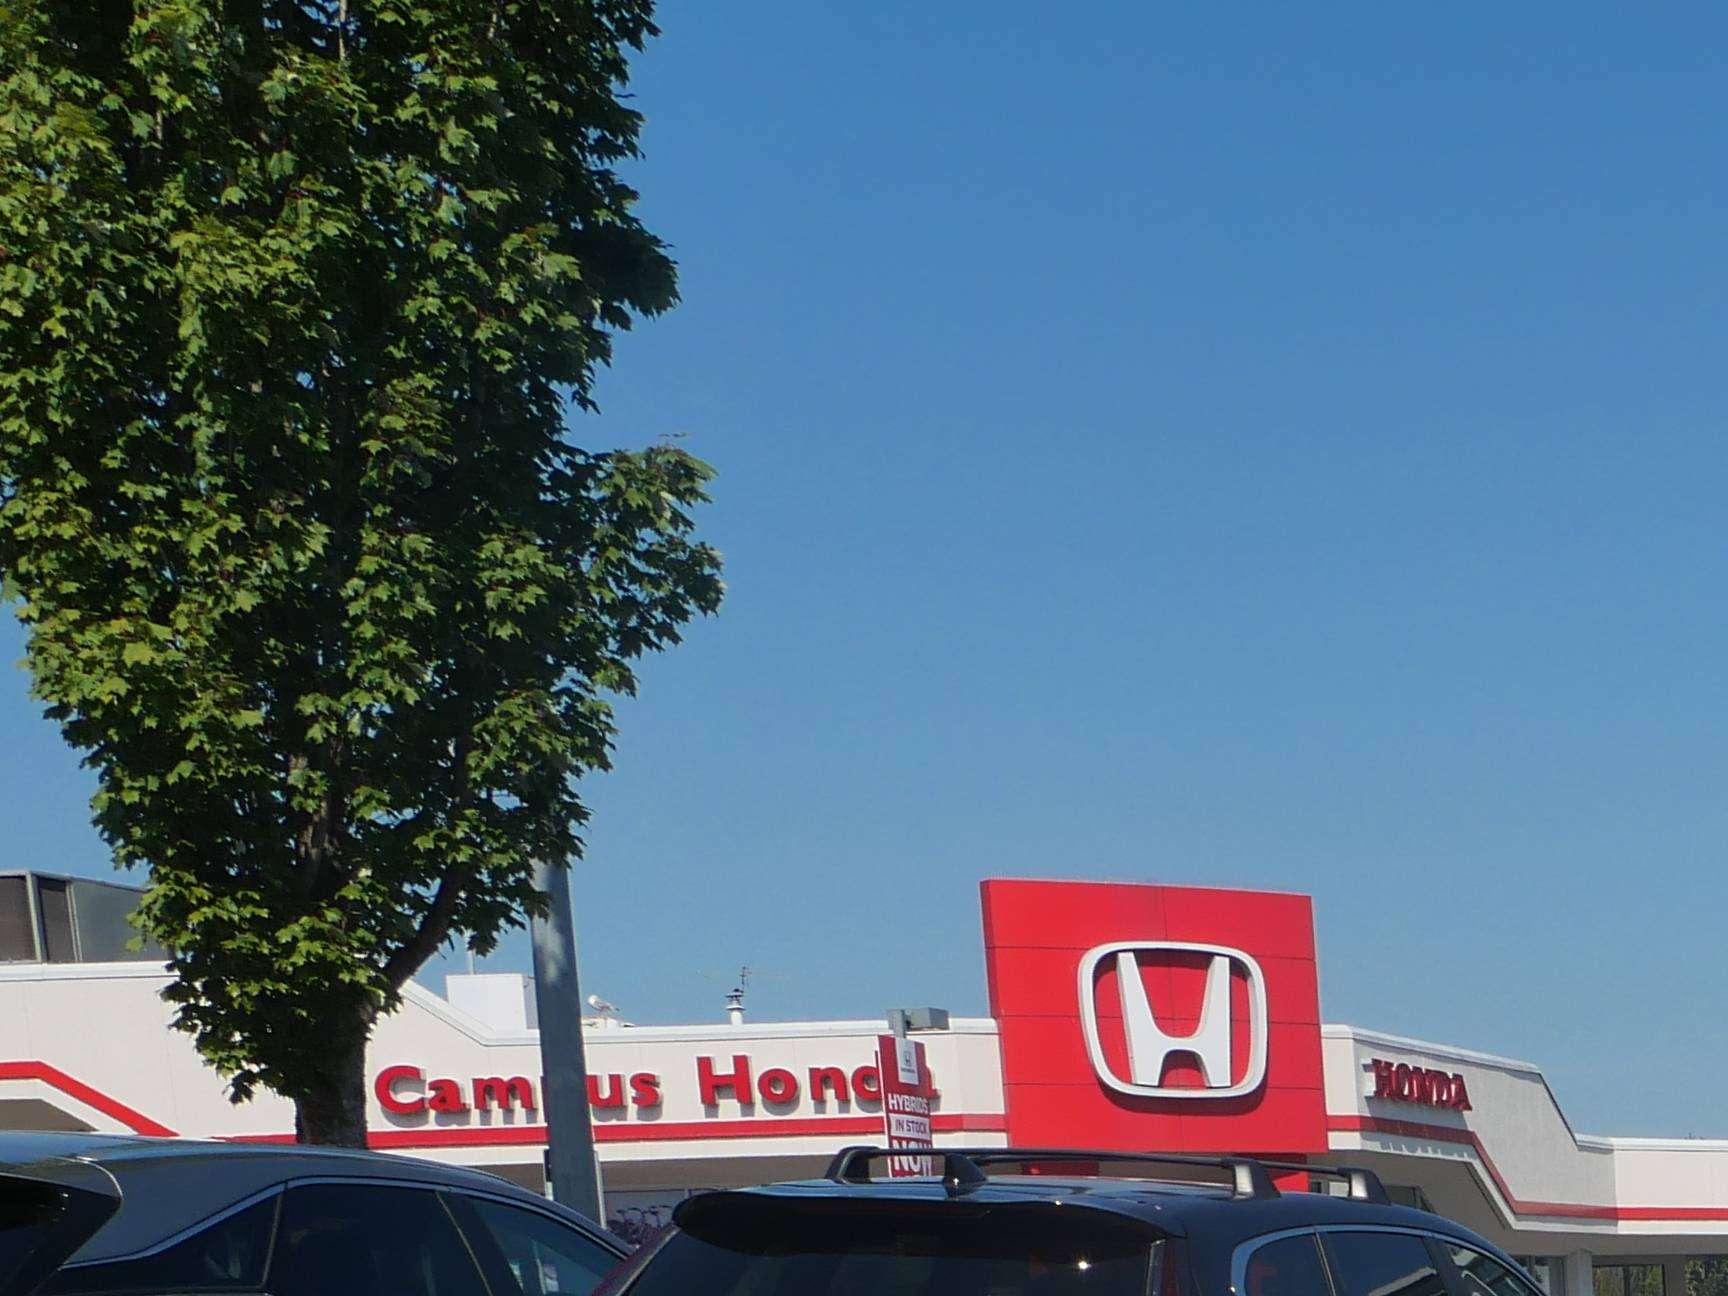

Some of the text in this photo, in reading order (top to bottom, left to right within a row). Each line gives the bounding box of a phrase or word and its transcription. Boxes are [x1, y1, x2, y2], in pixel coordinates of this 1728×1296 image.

[375, 1065, 659, 1113] Camus
[1371, 1058, 1472, 1111] HONDA
[888, 1093, 928, 1114] HYBRIDS
[896, 1119, 928, 1135] IN STOCK
